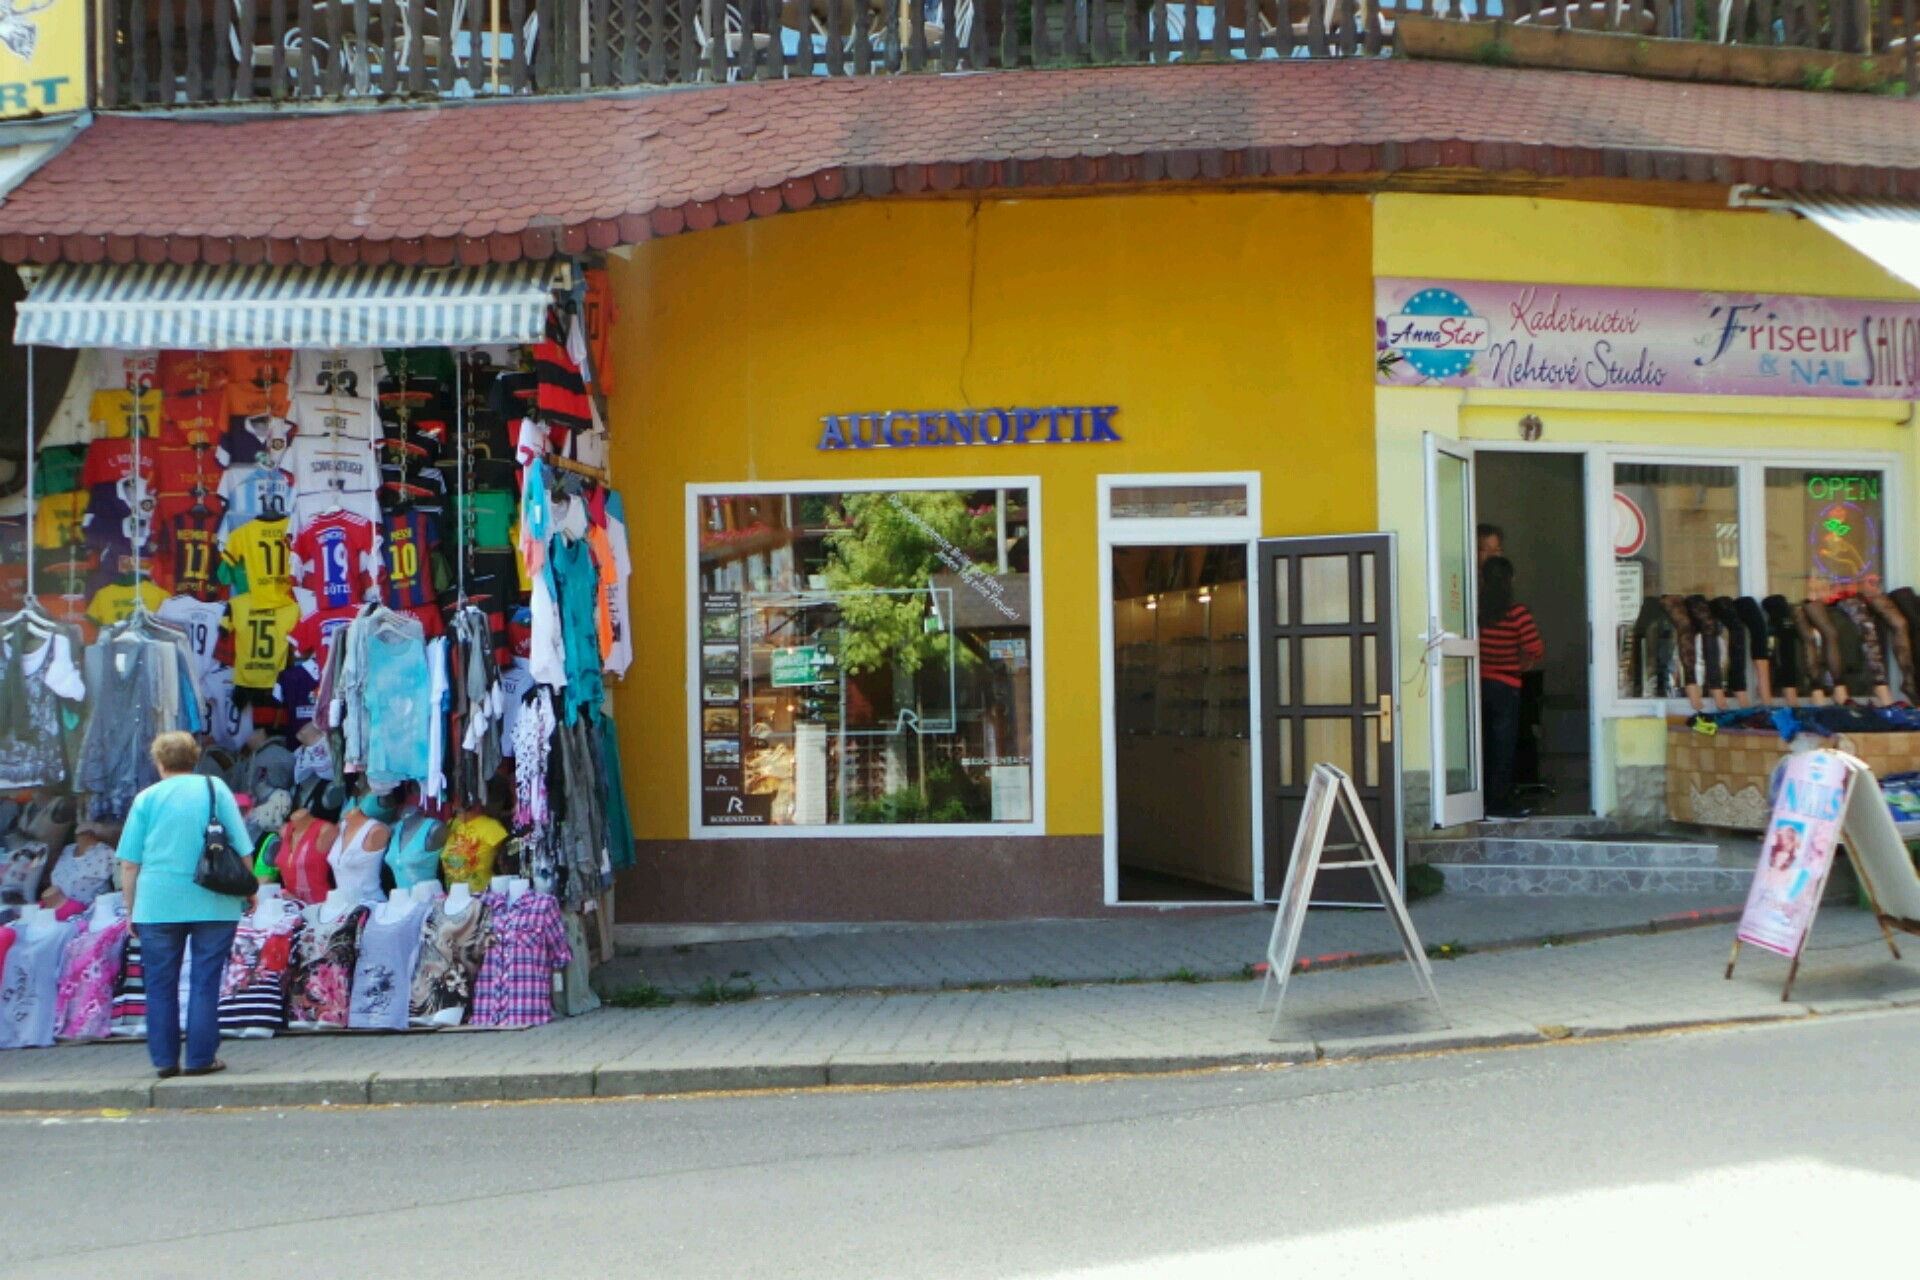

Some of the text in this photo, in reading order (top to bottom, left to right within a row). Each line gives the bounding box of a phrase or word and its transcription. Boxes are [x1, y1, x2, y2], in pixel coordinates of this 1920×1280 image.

[1693, 302, 1857, 366] Friseur
[1790, 358, 1862, 387] NAIL
[1862, 316, 1920, 388] SALO
[1489, 339, 1668, 388] Nehtové Studio
[817, 406, 1121, 449] AUGENOPTIK
[1807, 477, 1878, 500] OPEN
[321, 543, 349, 582] 19
[388, 542, 418, 580] 10
[247, 620, 276, 659] 15
